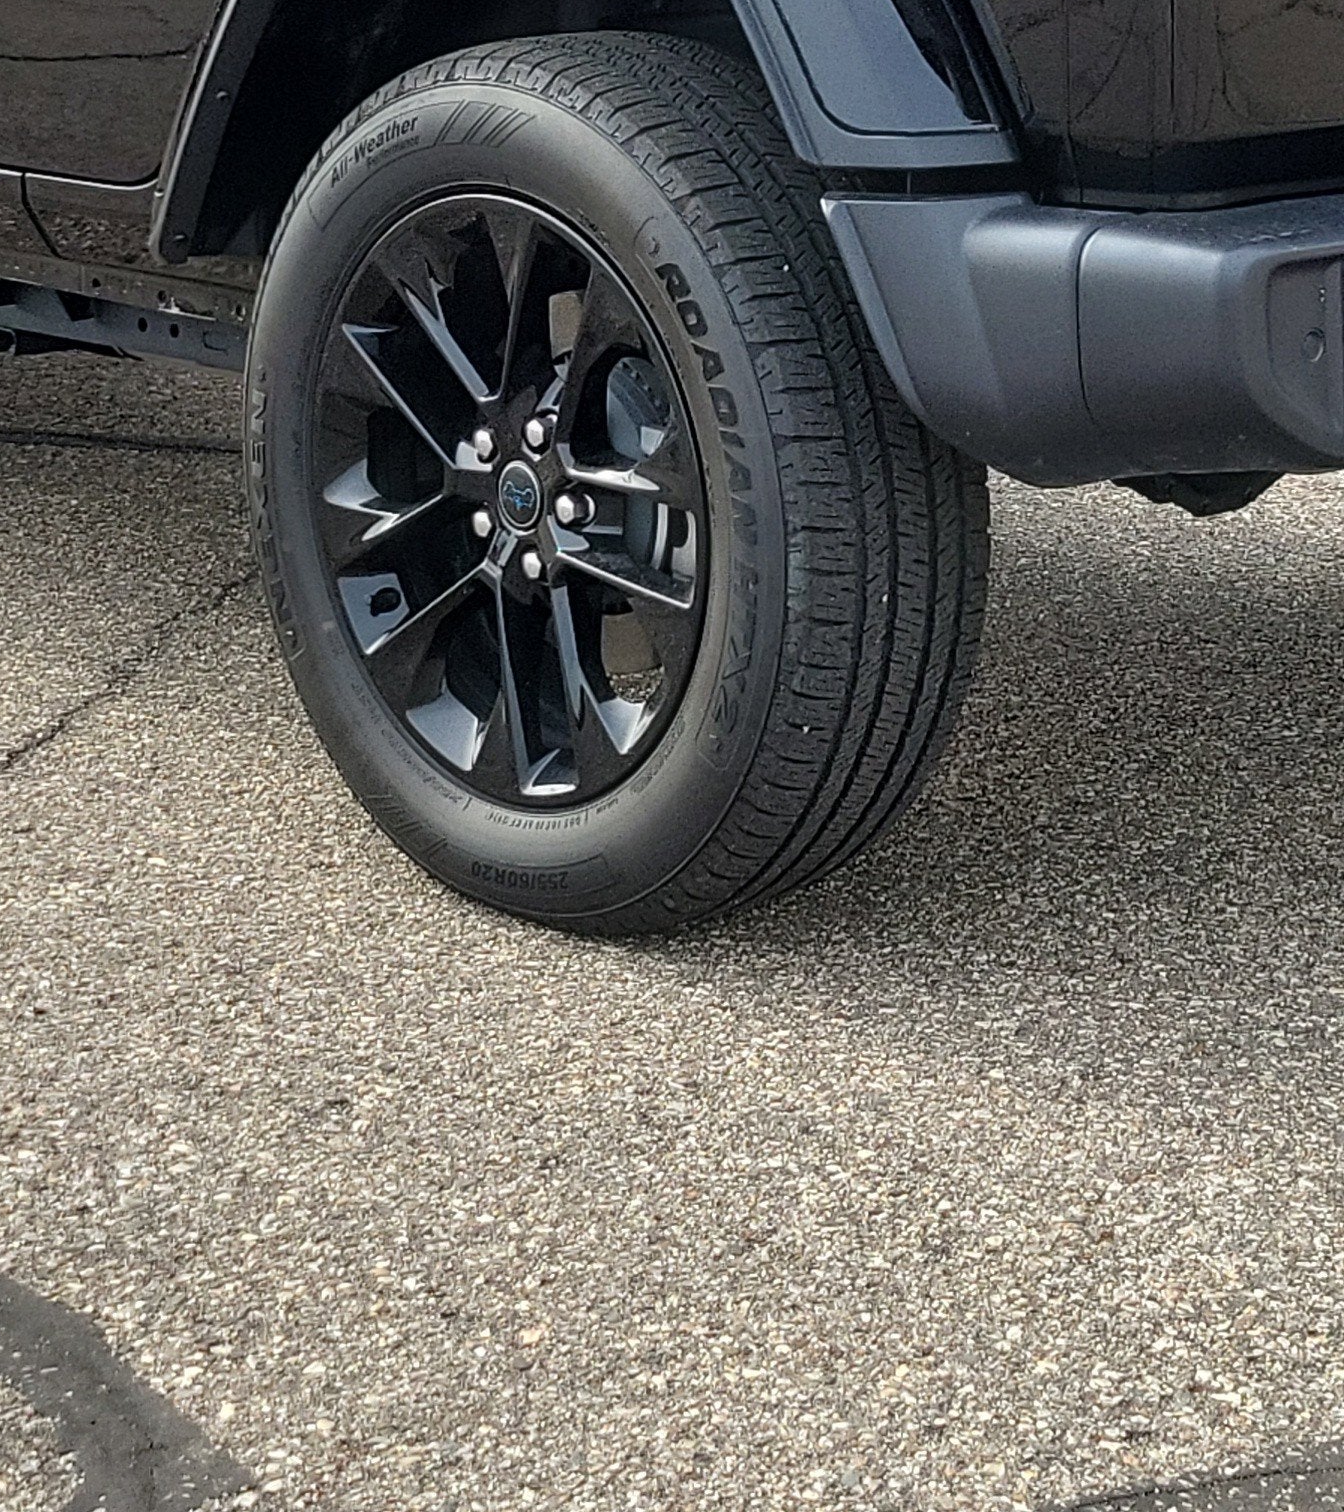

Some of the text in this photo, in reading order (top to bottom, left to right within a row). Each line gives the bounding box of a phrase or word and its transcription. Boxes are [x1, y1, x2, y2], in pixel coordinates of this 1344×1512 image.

[331, 116, 419, 188] All-Weather
[251, 390, 294, 623] NEXEN
[655, 262, 757, 547] ROADIAN
